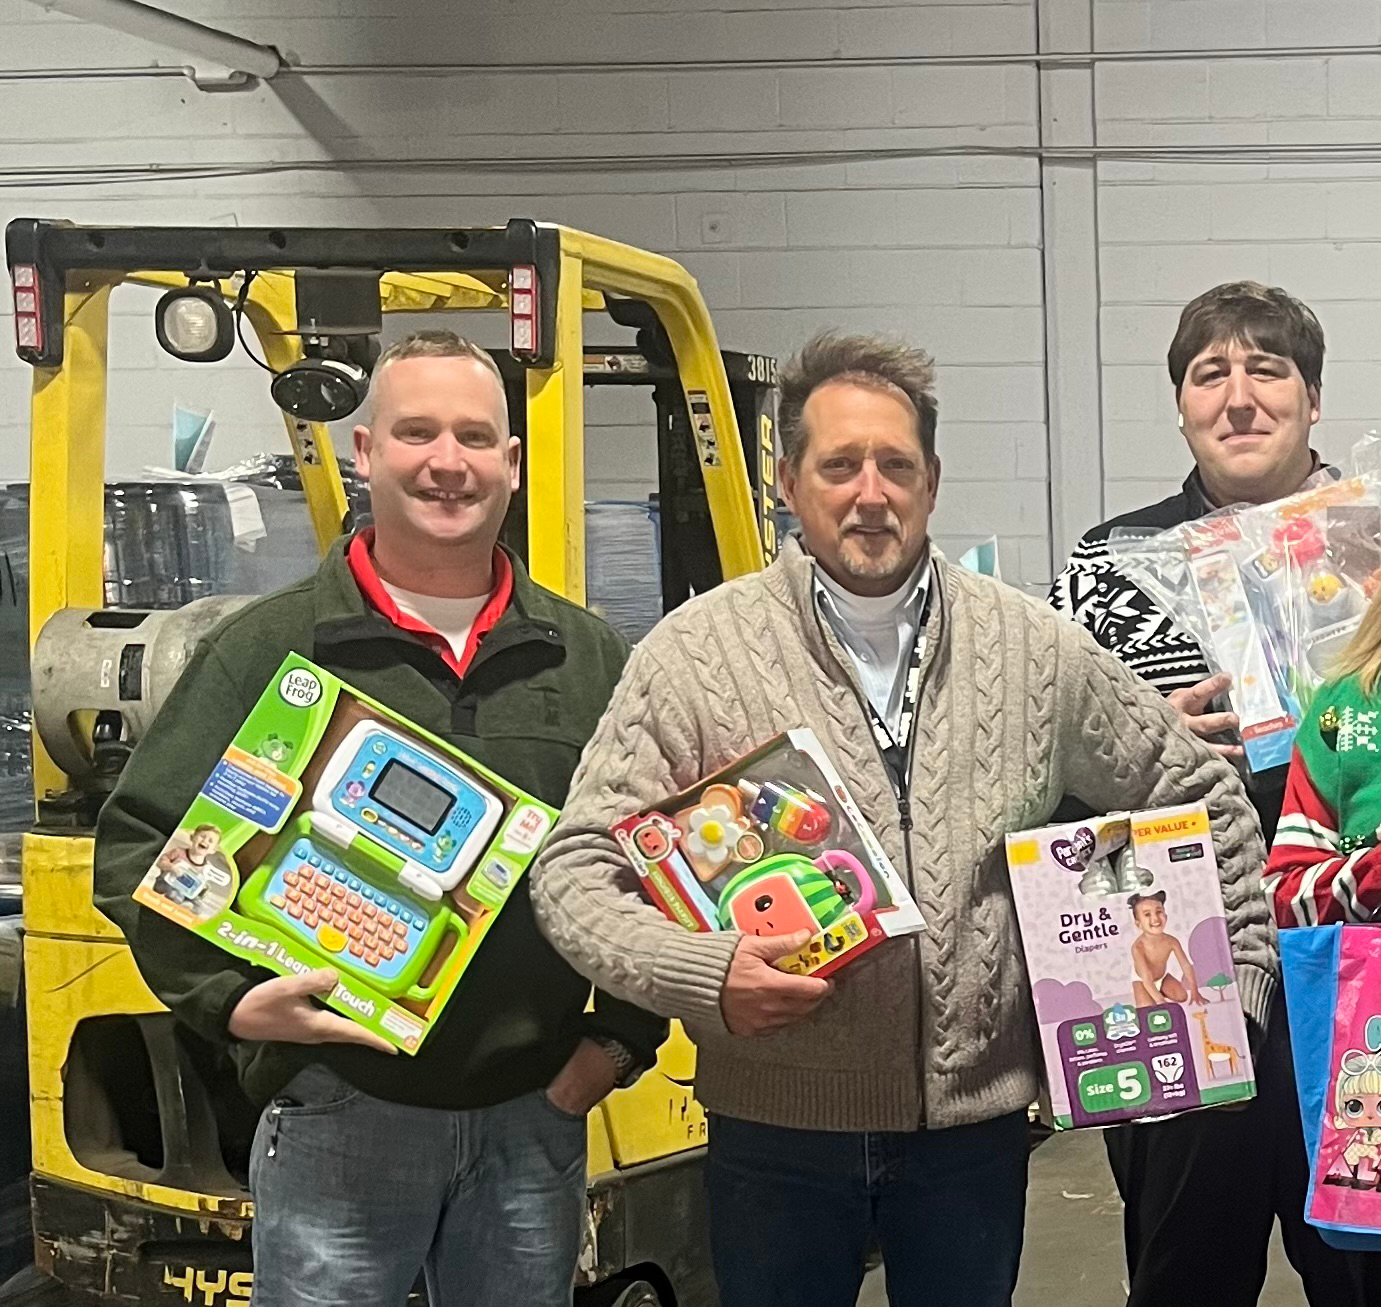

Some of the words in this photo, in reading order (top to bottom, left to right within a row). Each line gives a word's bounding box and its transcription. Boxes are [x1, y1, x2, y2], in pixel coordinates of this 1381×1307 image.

[288, 673, 317, 691] Leap
[285, 684, 315, 704] Frog
[1155, 820, 1190, 836] VALUE
[1060, 911, 1093, 928] Dry
[1098, 907, 1112, 921] &
[1058, 922, 1119, 945] Gentle
[1075, 942, 1108, 954] Diapers
[216, 921, 278, 956] 2-in-1
[276, 946, 317, 975] Leap
[334, 983, 378, 1018] Touch
[1075, 1028, 1095, 1041] 0%
[1157, 1056, 1178, 1069] 162
[1086, 1083, 1115, 1097] Size
[1117, 1067, 1142, 1100] 5
